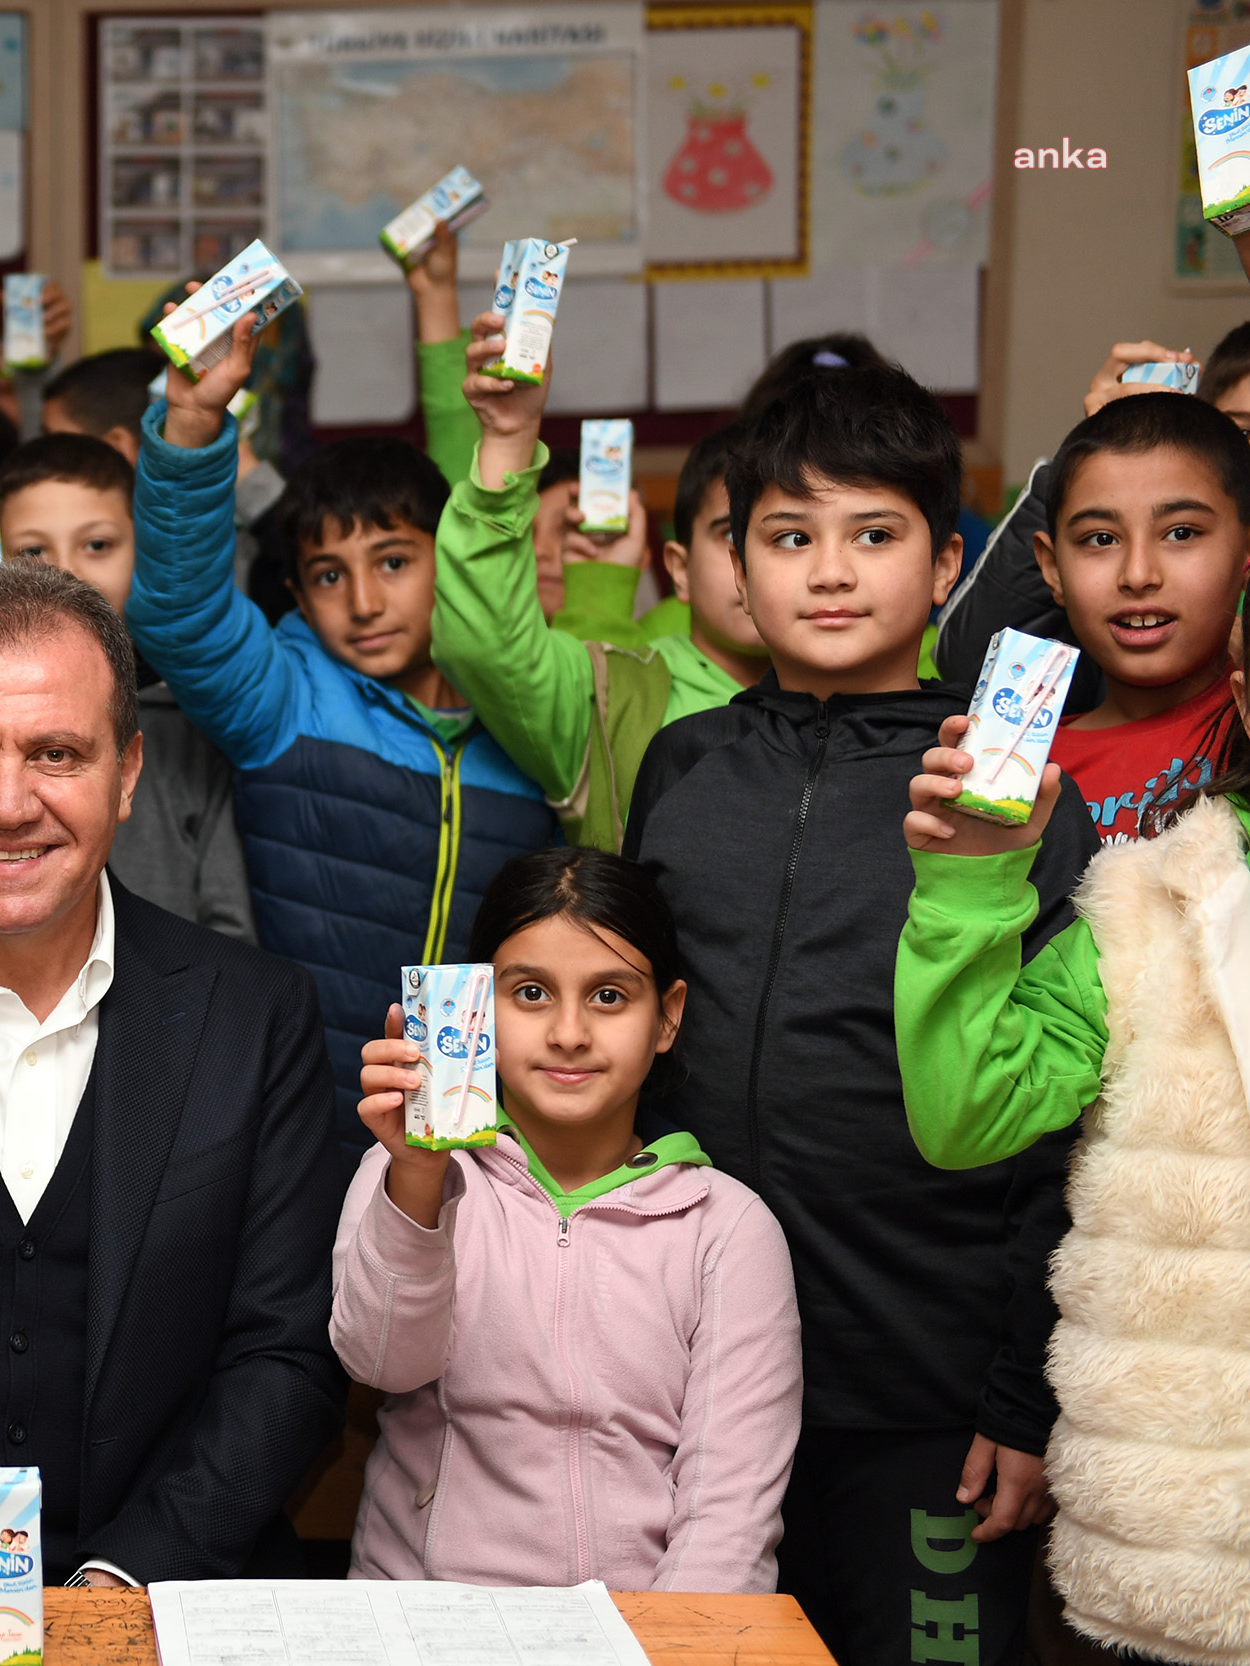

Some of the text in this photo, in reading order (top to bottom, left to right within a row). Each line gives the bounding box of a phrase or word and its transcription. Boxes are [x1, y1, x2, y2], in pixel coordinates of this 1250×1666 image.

[1203, 105, 1250, 134] SENİN
[995, 697, 1050, 727] SEN
[441, 1033, 488, 1054] SENN
